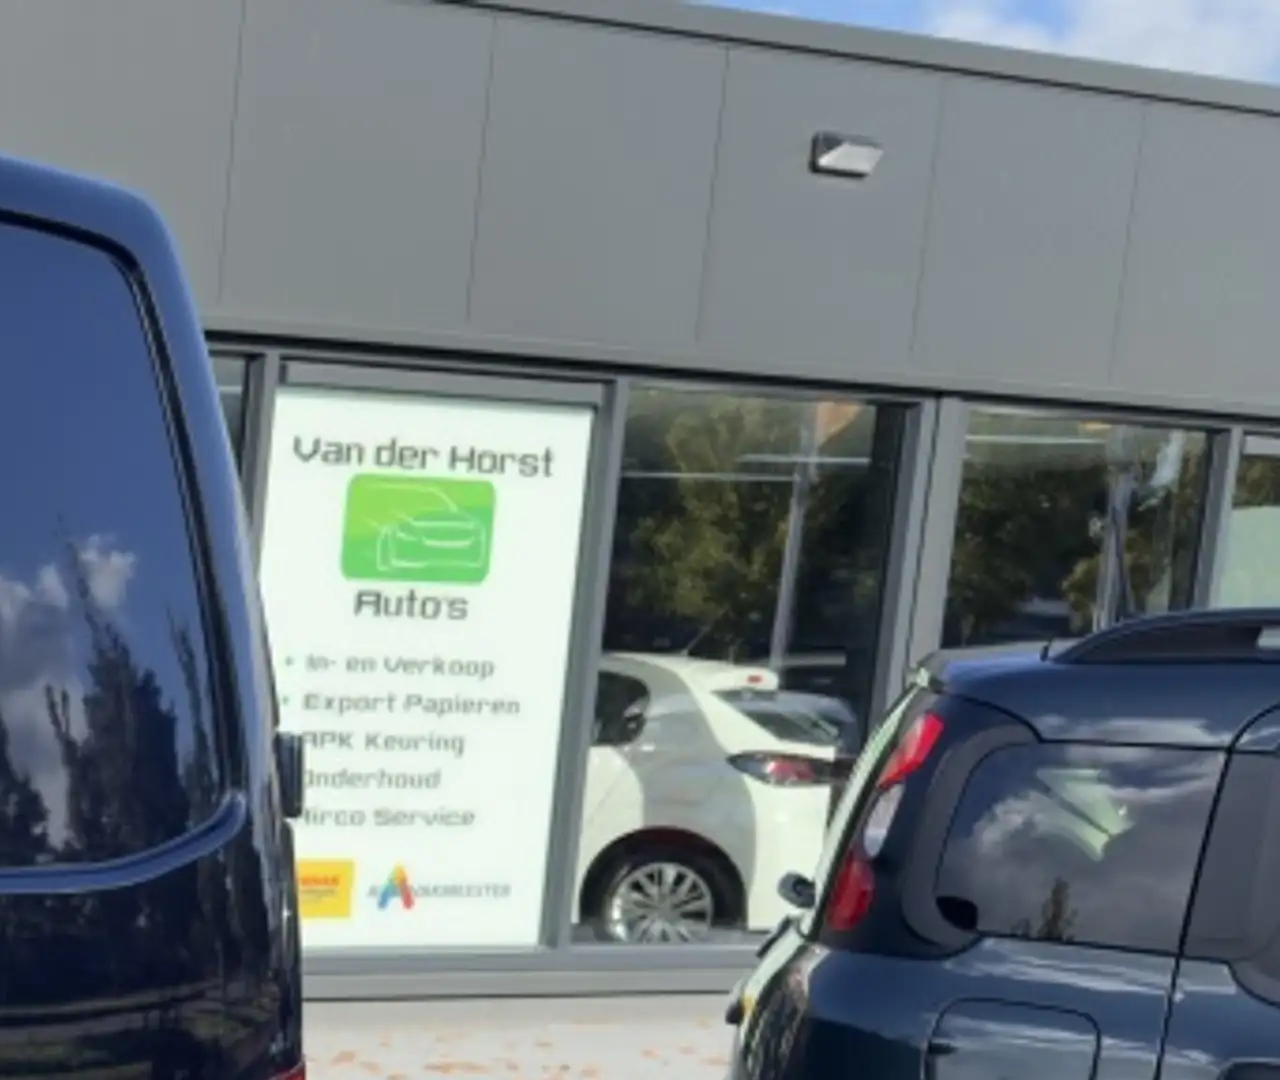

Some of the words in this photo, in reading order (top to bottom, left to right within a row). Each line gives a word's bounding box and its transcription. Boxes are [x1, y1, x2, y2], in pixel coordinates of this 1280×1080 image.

[292, 436, 366, 466] Van
[374, 437, 441, 470] der
[448, 445, 556, 478] Horst
[354, 589, 469, 621] Auto's
[345, 656, 378, 674] en
[383, 656, 497, 681] Verkoop
[303, 692, 397, 717] Export
[402, 693, 521, 718] Papieren
[364, 732, 466, 759] Keuring
[372, 808, 477, 828] Service
